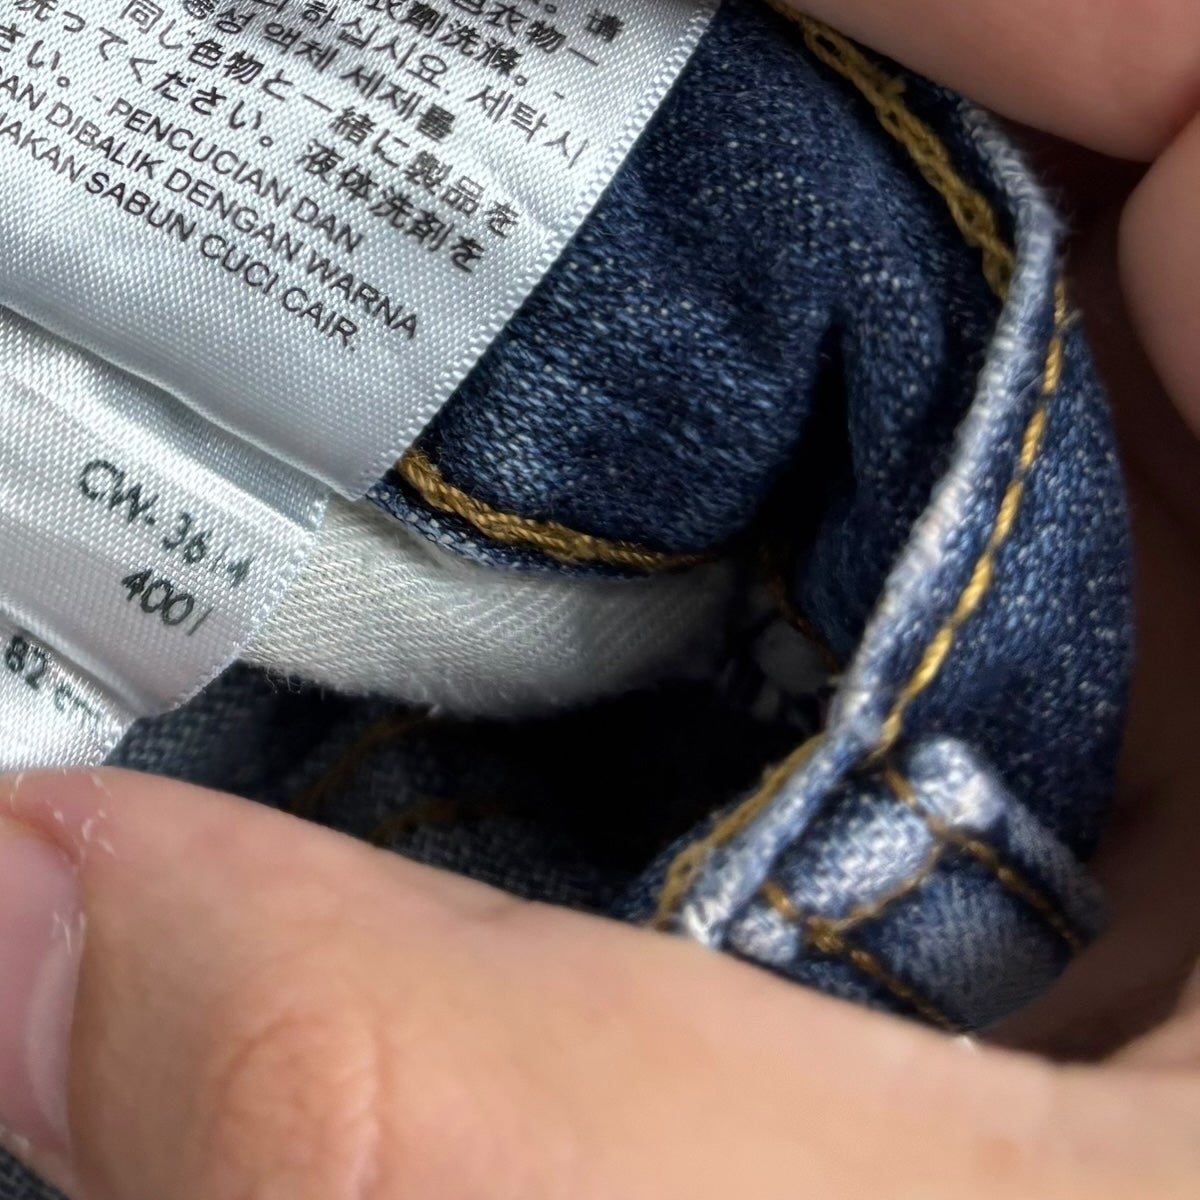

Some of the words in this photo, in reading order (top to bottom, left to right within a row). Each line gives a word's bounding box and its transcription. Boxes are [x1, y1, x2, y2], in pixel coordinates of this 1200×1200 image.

[45, 101, 164, 180] DIBALIK
[163, 167, 305, 264] DENGAN
[306, 255, 419, 341] WARNA
[84, 171, 197, 243] SABUN
[199, 232, 280, 296] CUCI
[279, 285, 363, 352] CAIR.
[108, 97, 293, 208] PENCUCIAN
[291, 195, 365, 255] DAN
